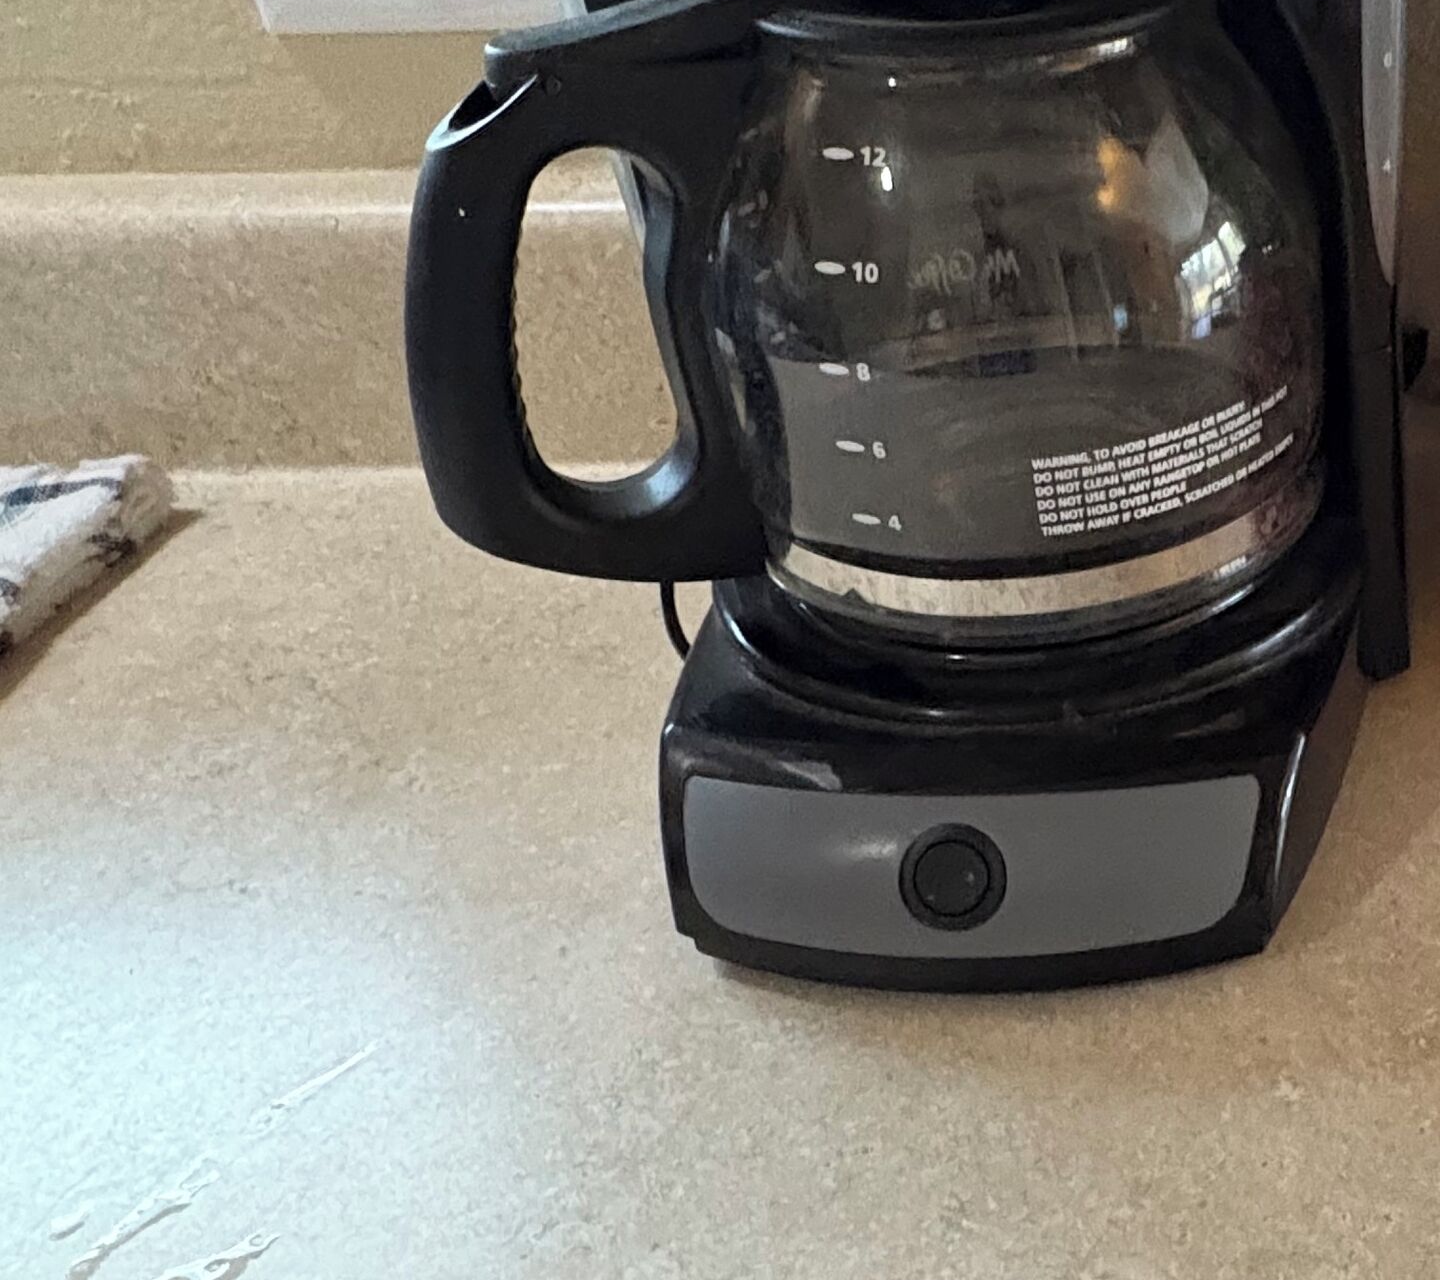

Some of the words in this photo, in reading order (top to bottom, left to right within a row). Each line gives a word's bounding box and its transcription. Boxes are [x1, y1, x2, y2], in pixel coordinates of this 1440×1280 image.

[860, 145, 887, 168] 12
[851, 261, 880, 286] 10
[856, 362, 871, 382] 8
[872, 441, 887, 460] 6
[1033, 471, 1053, 485] DO
[1054, 467, 1079, 482] NOT
[1118, 452, 1146, 470] HEAT
[1147, 440, 1182, 463] EMPTY
[1183, 435, 1198, 451] OR
[1220, 411, 1252, 436] LIQUIDS
[1034, 485, 1054, 498] DO
[1056, 481, 1081, 496] NOT
[1083, 474, 1119, 491] CLEAN
[1120, 466, 1150, 483] WITH
[1151, 447, 1205, 476] MATERIALS
[1206, 435, 1228, 455] THAT
[1229, 417, 1263, 444] SCRATCH
[1093, 448, 1110, 462] TO
[1112, 438, 1147, 458] AVOID
[1148, 420, 1200, 448] BREAKAGE
[1201, 415, 1216, 430] OR
[1036, 498, 1056, 512] DO
[1057, 494, 1083, 509] NOT
[1084, 489, 1106, 504] USE
[1108, 485, 1126, 500] ON
[1128, 476, 1151, 494] ANY
[1152, 460, 1206, 488] RANGETOP
[1206, 454, 1220, 469] OR
[1220, 445, 1239, 463] HOT
[1239, 431, 1262, 454] PLATE
[1041, 521, 1085, 537] THROW
[1087, 514, 1120, 532] AWAY
[1122, 509, 1132, 524] IF
[1184, 473, 1235, 504] SCRATCHED
[1235, 466, 1248, 482] OR
[1248, 449, 1275, 474] HEATED
[888, 514, 903, 532] 4
[1038, 512, 1058, 525] DO
[1059, 507, 1085, 522] NOT
[1086, 501, 1119, 518] HOLD
[1119, 493, 1150, 511] OVER
[1151, 481, 1188, 501] PEOPLE
